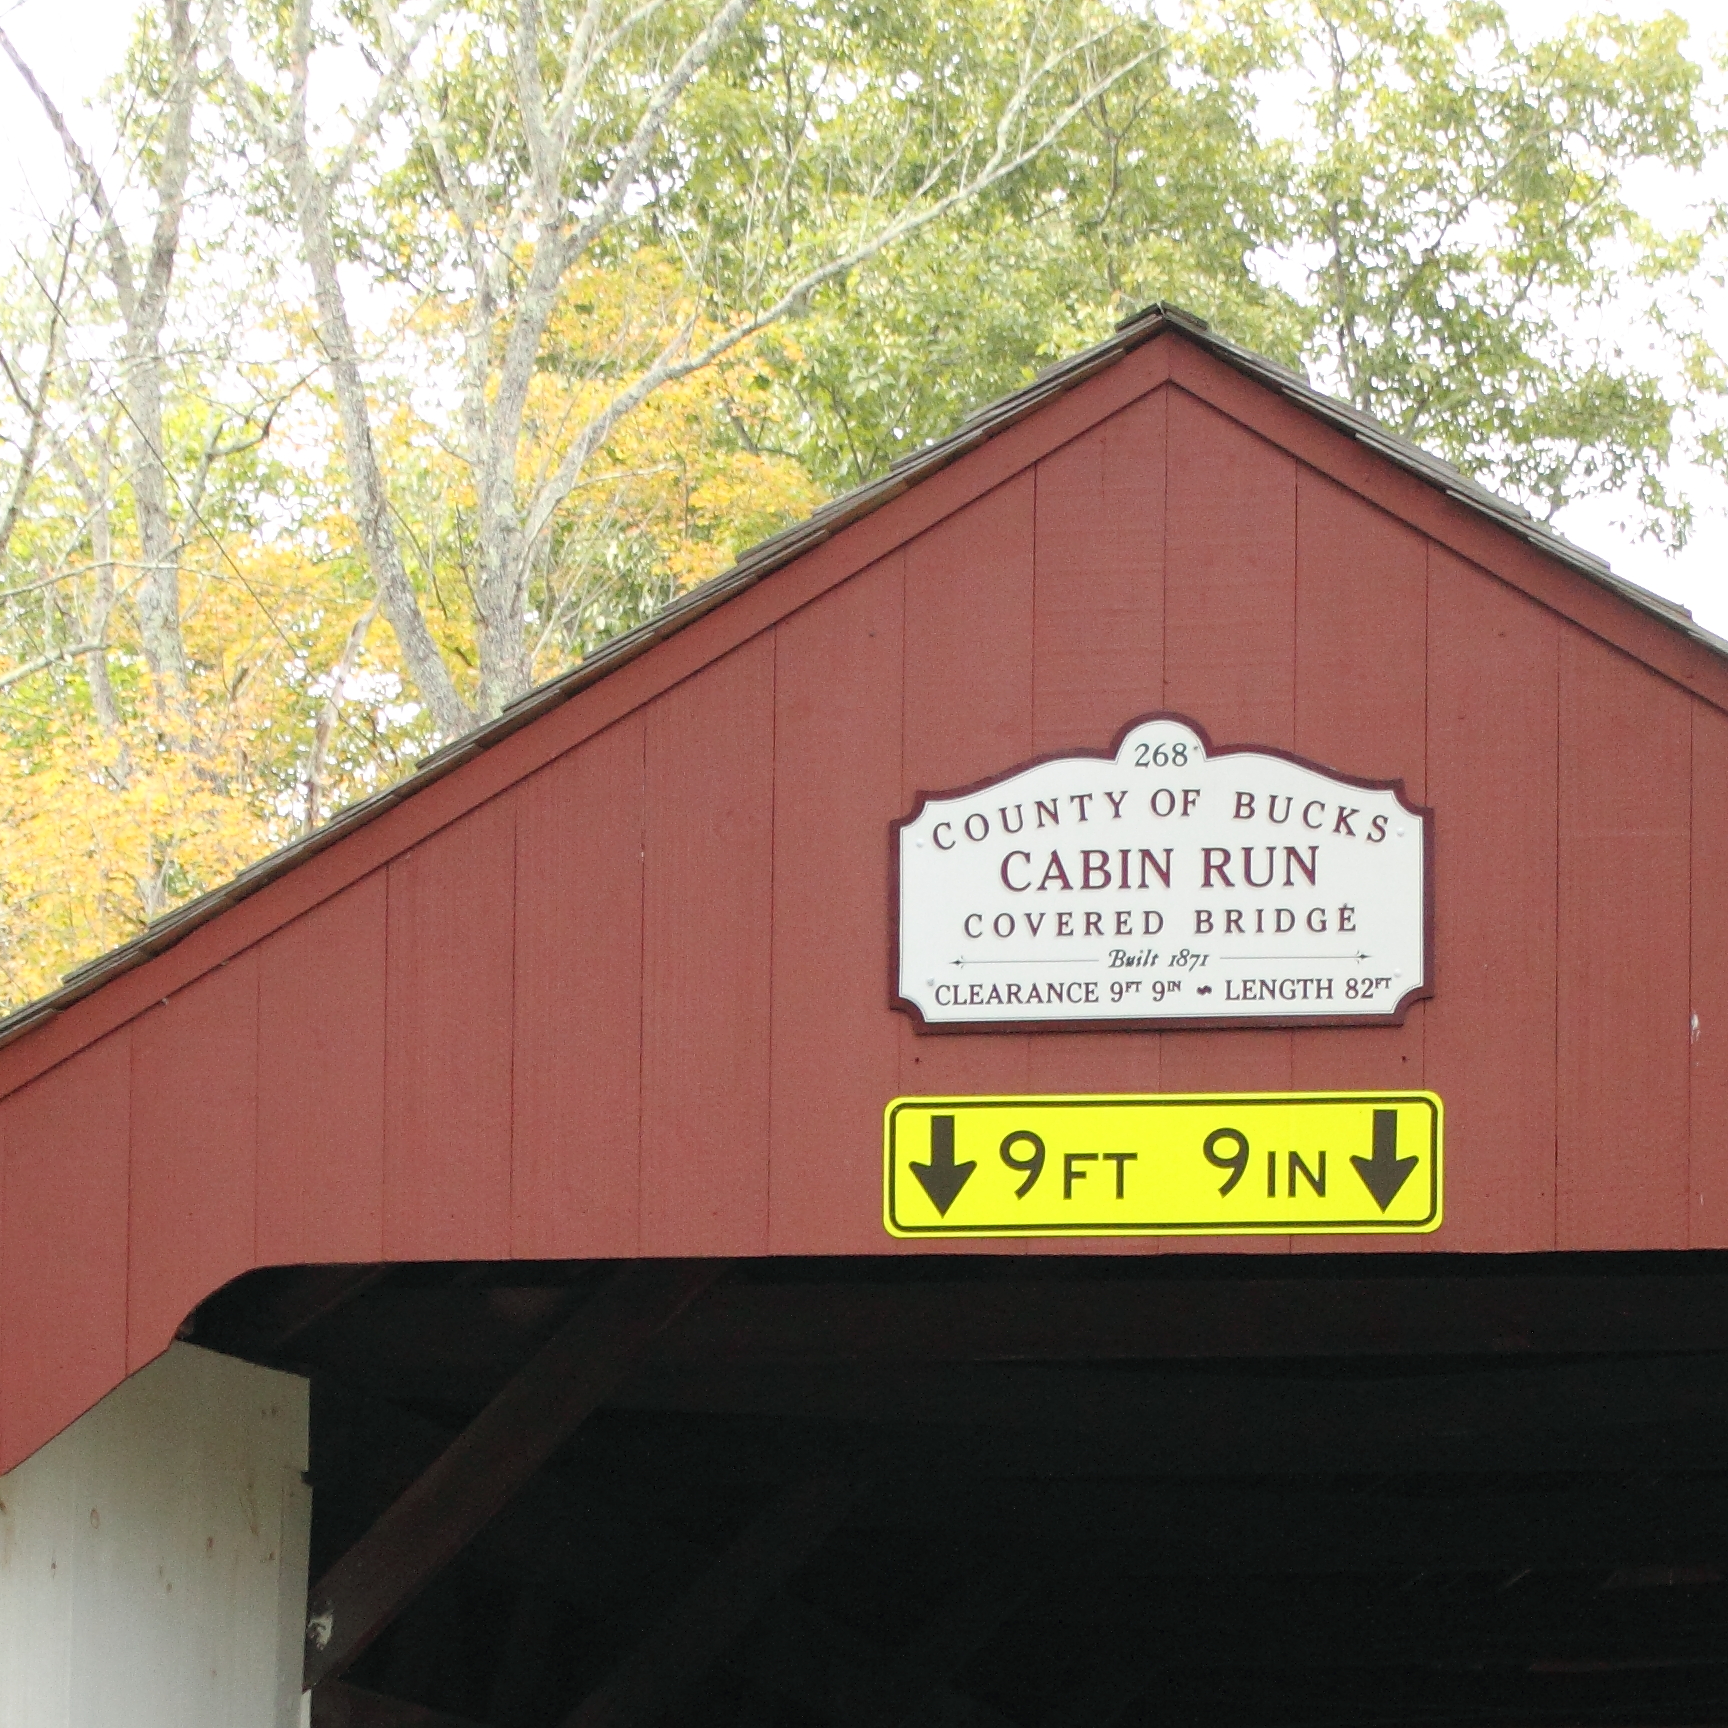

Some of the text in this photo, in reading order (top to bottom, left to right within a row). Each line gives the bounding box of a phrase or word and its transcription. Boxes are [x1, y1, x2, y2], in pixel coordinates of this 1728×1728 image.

[1134, 742, 1189, 768] 268
[931, 788, 1390, 851] COUNTY OF BUCKS
[999, 844, 1321, 892] CABIN RUN
[963, 905, 1357, 939] COVERED BRIDGE
[1107, 948, 1210, 972] Built 1871
[934, 981, 1100, 1006] CLEARANCE
[1224, 977, 1335, 1001] LENGTH
